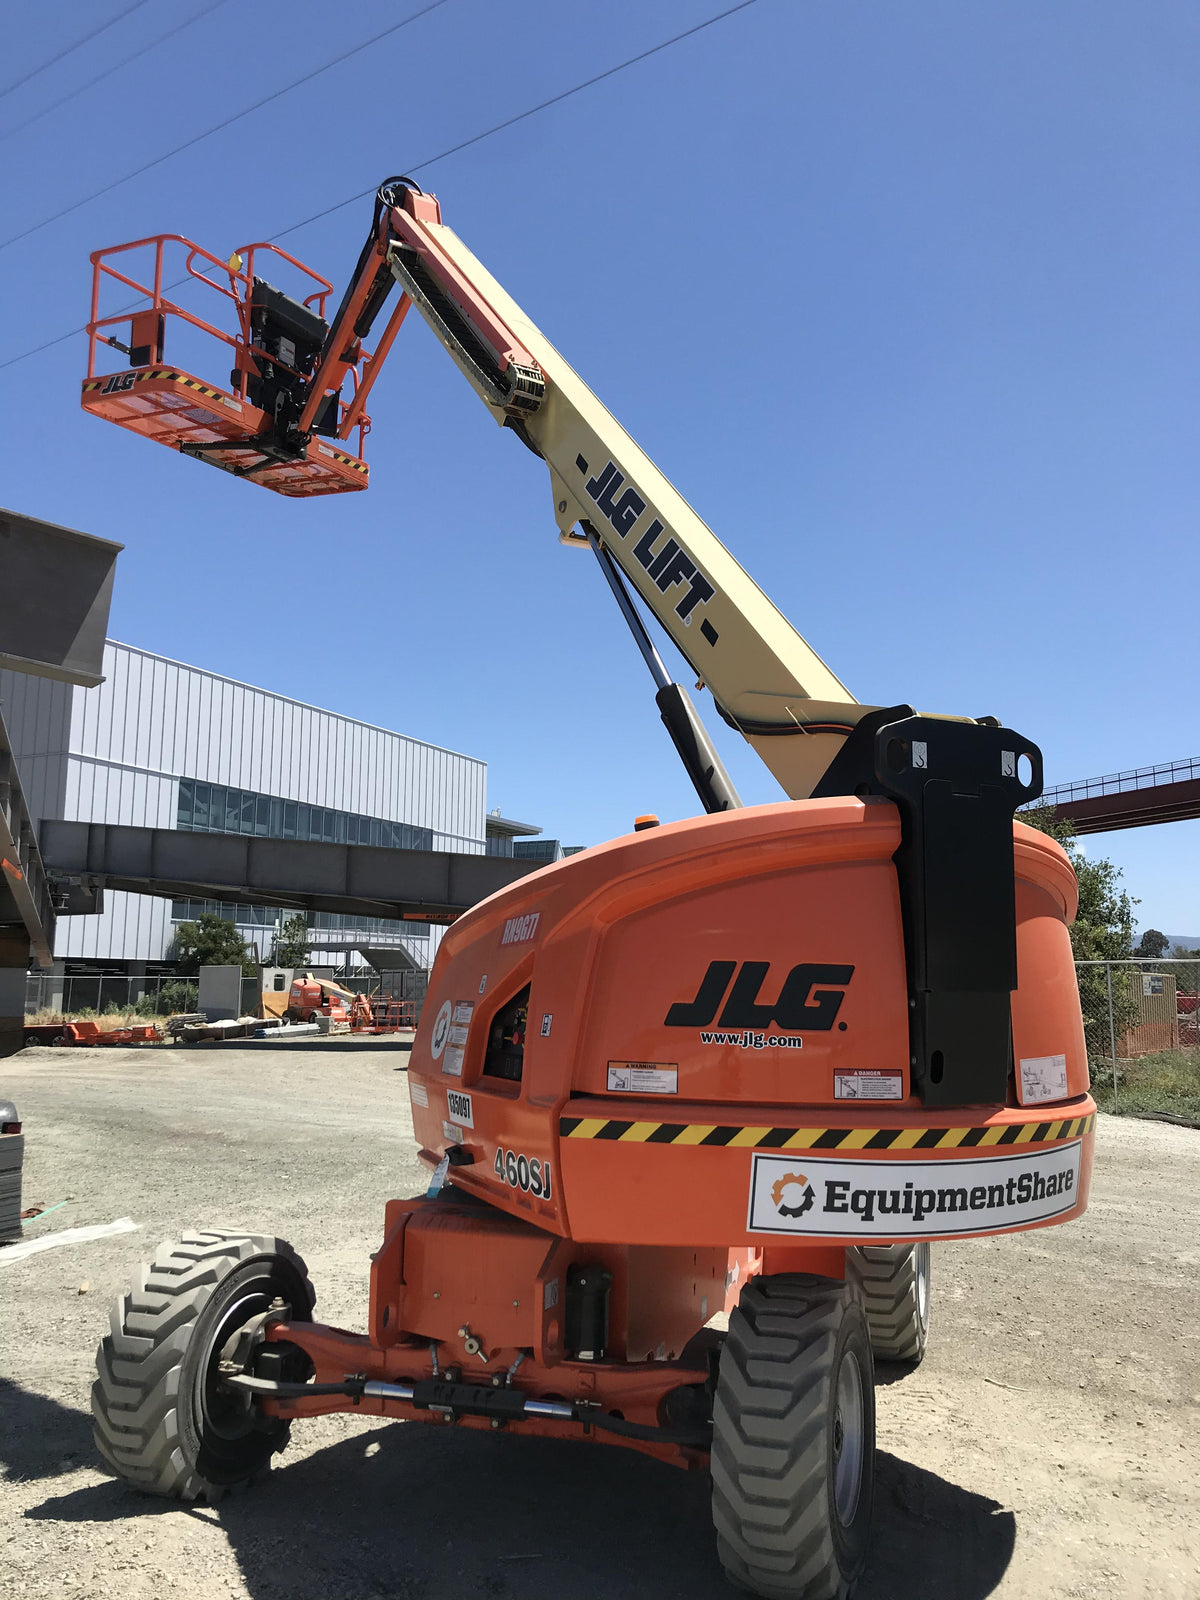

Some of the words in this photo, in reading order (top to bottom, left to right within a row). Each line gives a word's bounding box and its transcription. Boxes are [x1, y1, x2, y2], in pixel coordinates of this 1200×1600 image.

[101, 371, 138, 395] JLG
[584, 460, 647, 540] JLG
[632, 517, 716, 622] LIFT
[664, 960, 856, 1031] JLG
[700, 1031, 803, 1049] www.jlg.com
[494, 1147, 551, 1201] 460SJ
[822, 1167, 1075, 1222] EquipmentShare
